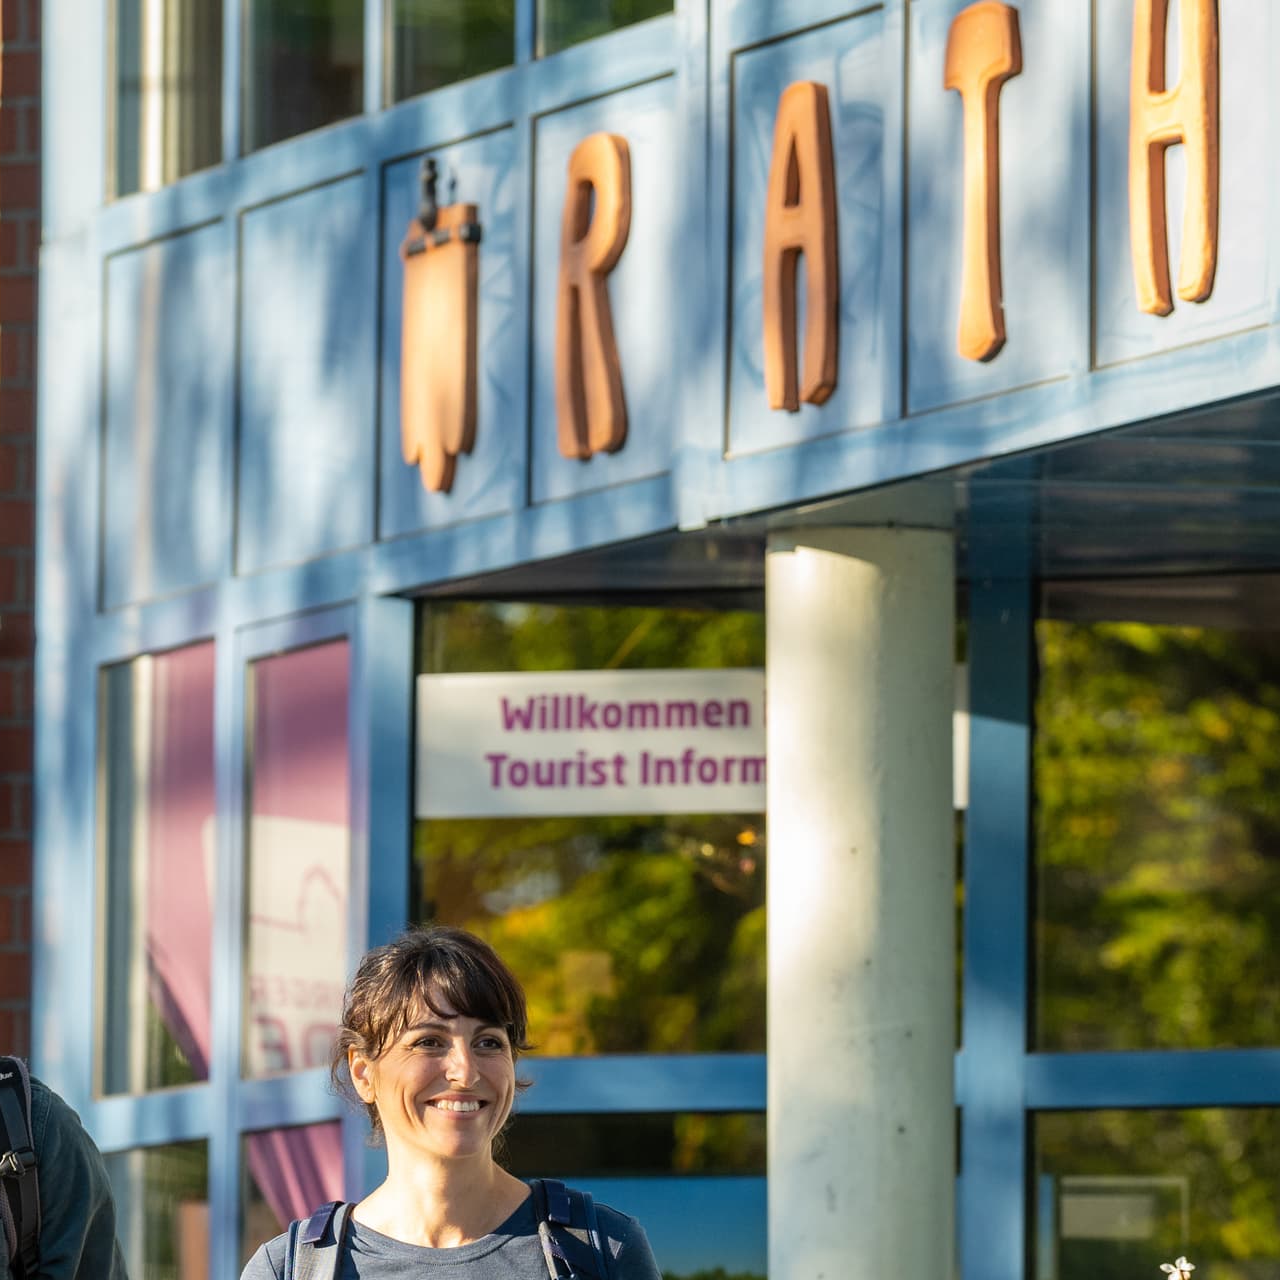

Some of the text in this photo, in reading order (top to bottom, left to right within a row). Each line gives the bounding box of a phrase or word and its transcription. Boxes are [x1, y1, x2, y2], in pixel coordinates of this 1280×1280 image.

[500, 694, 751, 732] Willkommen
[485, 748, 767, 788] Tourist Inform
